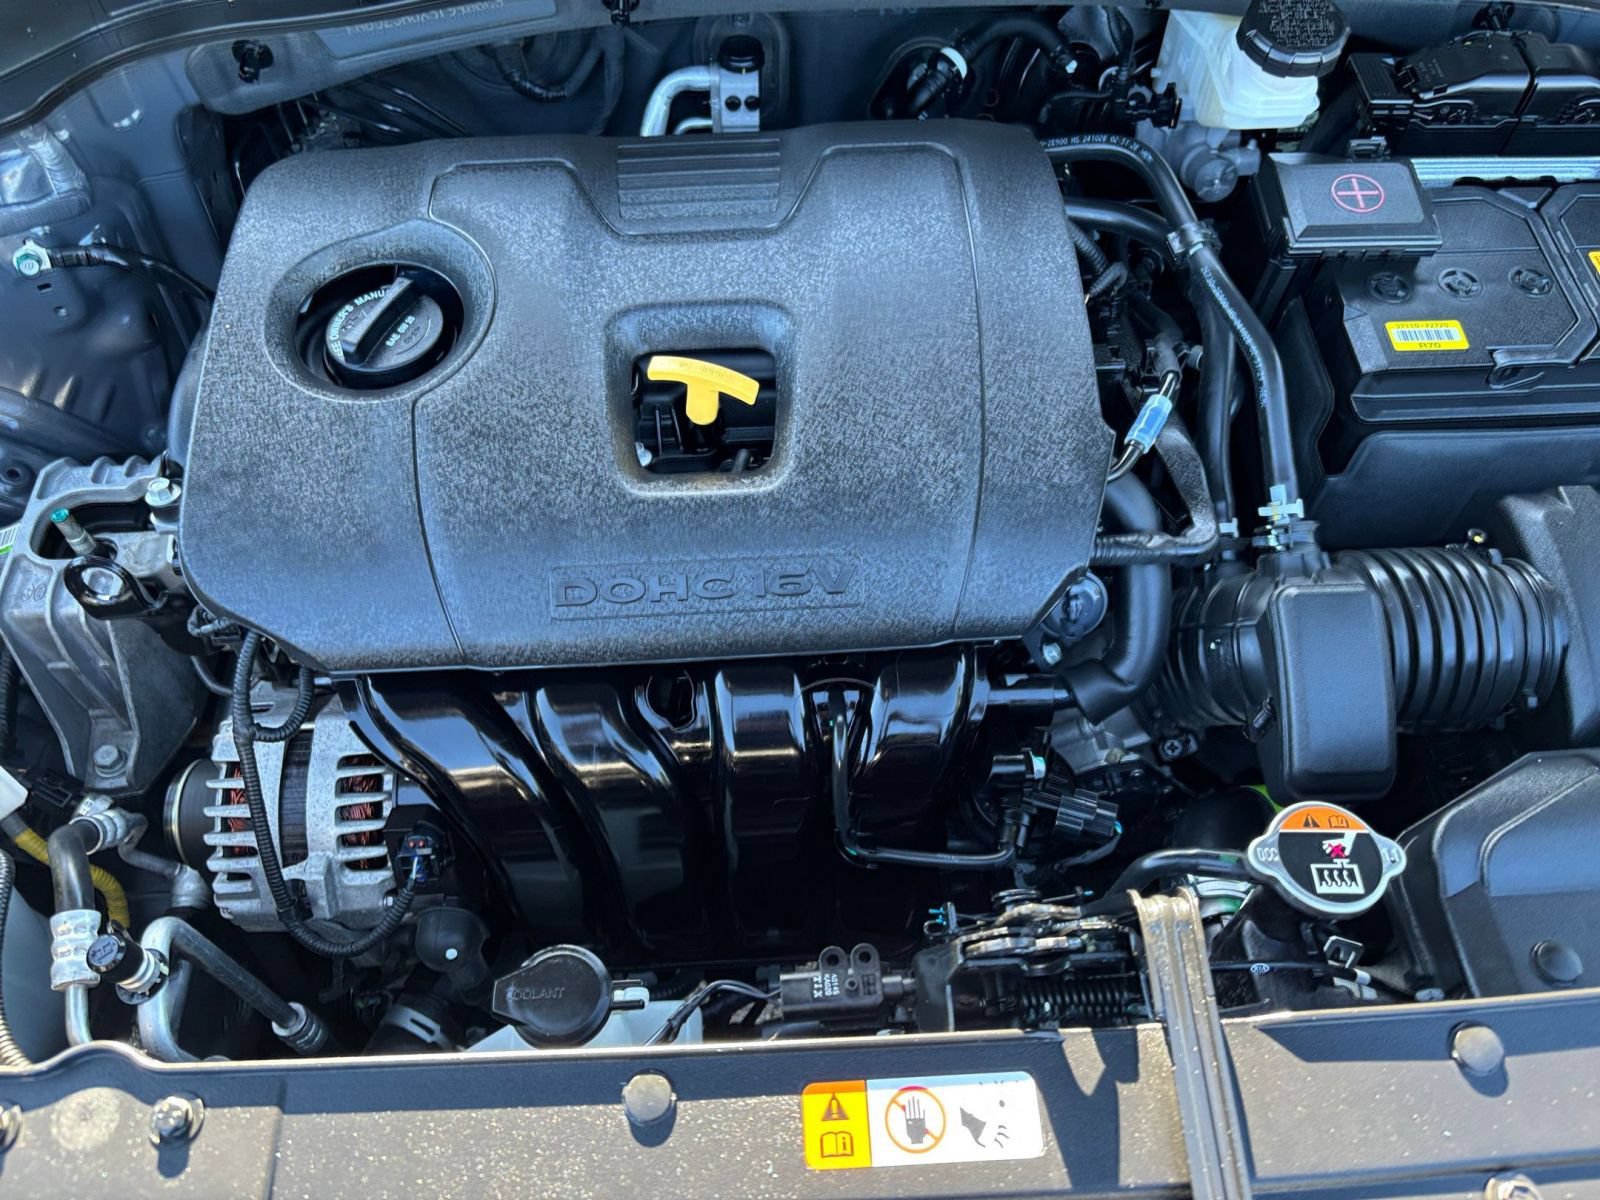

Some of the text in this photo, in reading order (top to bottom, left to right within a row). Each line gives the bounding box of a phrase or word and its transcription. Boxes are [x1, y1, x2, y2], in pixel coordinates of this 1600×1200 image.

[330, 304, 354, 340] OWNER'S
[354, 289, 386, 305] MANU
[552, 567, 857, 607] DOHC 16V
[506, 986, 565, 1001] COOLANT
[813, 975, 823, 998] TIX
